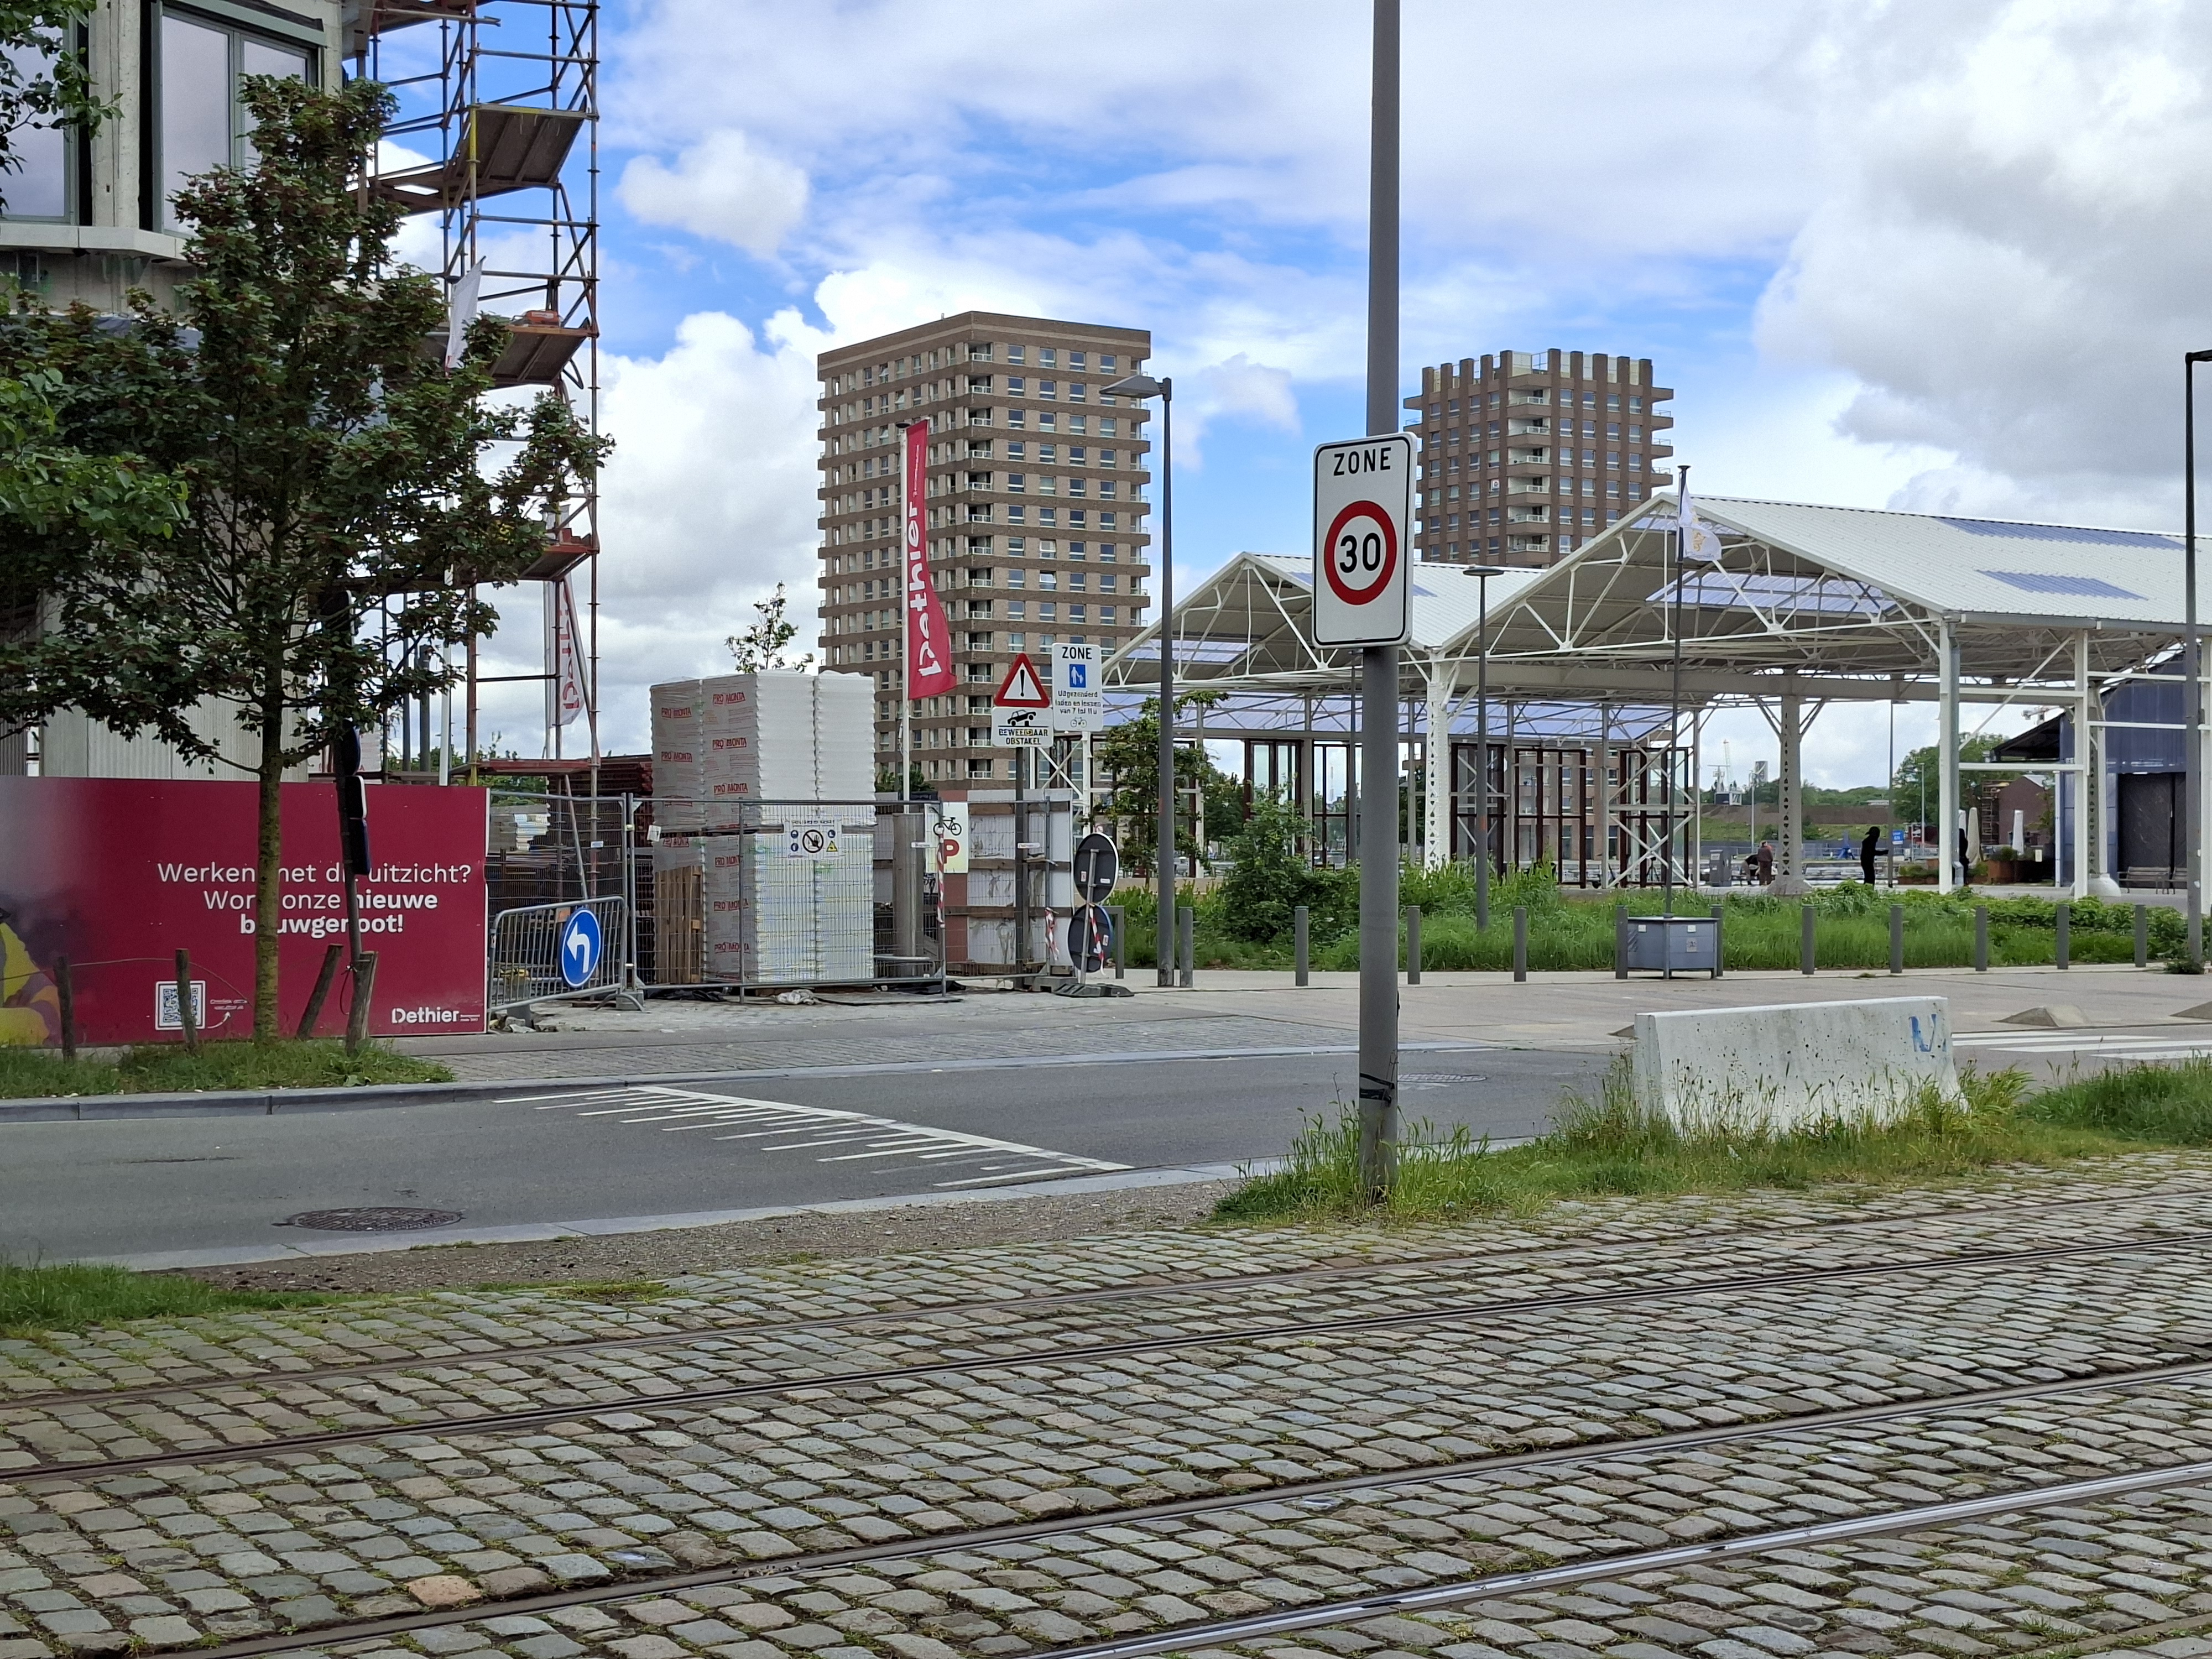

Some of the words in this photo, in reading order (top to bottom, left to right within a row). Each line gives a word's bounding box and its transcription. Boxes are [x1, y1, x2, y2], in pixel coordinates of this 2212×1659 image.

[1333, 447, 1391, 476] ZONE
[1339, 533, 1381, 573] 30
[908, 502, 942, 676] Dethier
[1062, 646, 1093, 660] ZONE
[713, 694, 723, 705] PRO
[713, 739, 723, 749] PRO
[726, 737, 747, 749] MONTA
[713, 785, 726, 795] PRO
[727, 783, 748, 794] MONTA
[943, 839, 959, 863] P
[158, 862, 255, 882] Werken
[368, 863, 471, 883] uitzicht?
[204, 890, 256, 910] Wor
[282, 894, 341, 910] onze
[356, 889, 438, 909] nieuwe
[714, 901, 725, 911] PRO
[241, 914, 403, 938] buwgenoot!
[392, 1006, 460, 1024] Dethier
